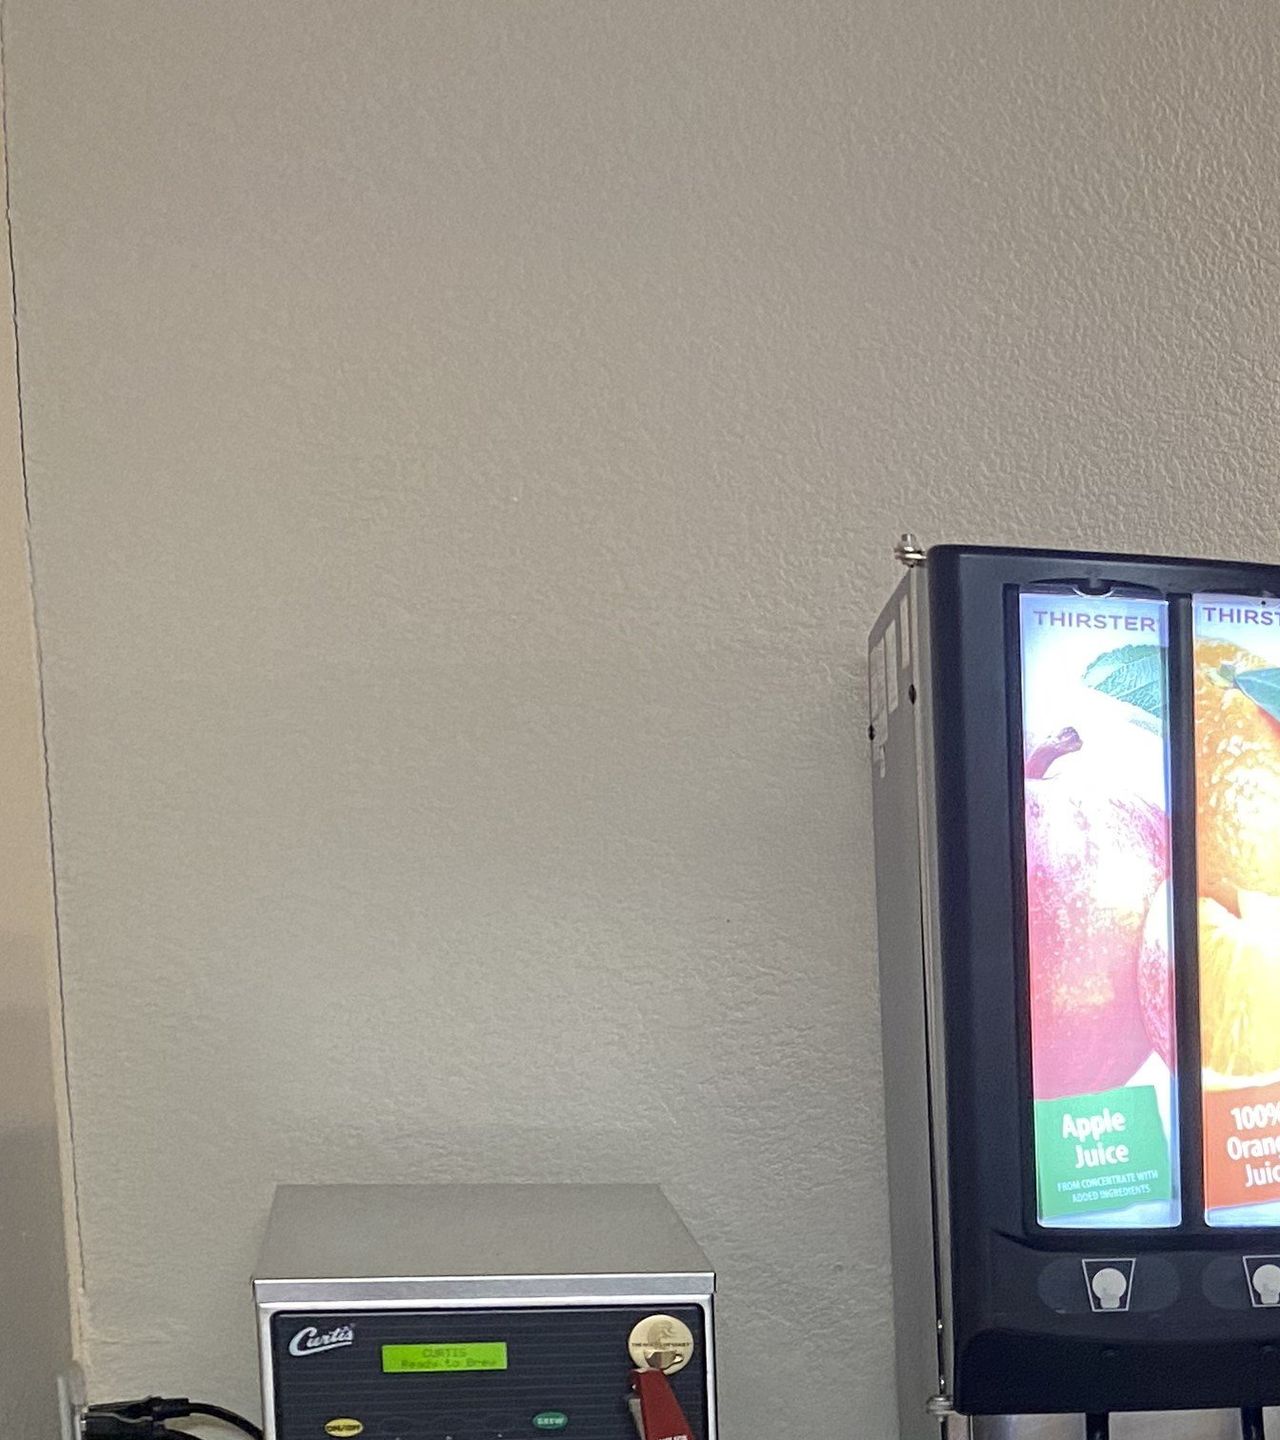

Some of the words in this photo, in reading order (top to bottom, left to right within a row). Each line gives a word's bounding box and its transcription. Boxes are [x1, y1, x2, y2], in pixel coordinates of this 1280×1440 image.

[1033, 610, 1156, 632] THIRSTER
[1062, 1108, 1126, 1142] Apple
[1075, 1144, 1130, 1169] Juice
[1057, 1180, 1079, 1193] FROM
[1081, 1173, 1135, 1189] CONCENTRATE
[1136, 1170, 1159, 1182] WITH
[1072, 1191, 1098, 1203] ADDED
[1099, 1185, 1151, 1201] INGREDIENTS
[289, 1325, 355, 1356] Curtis
